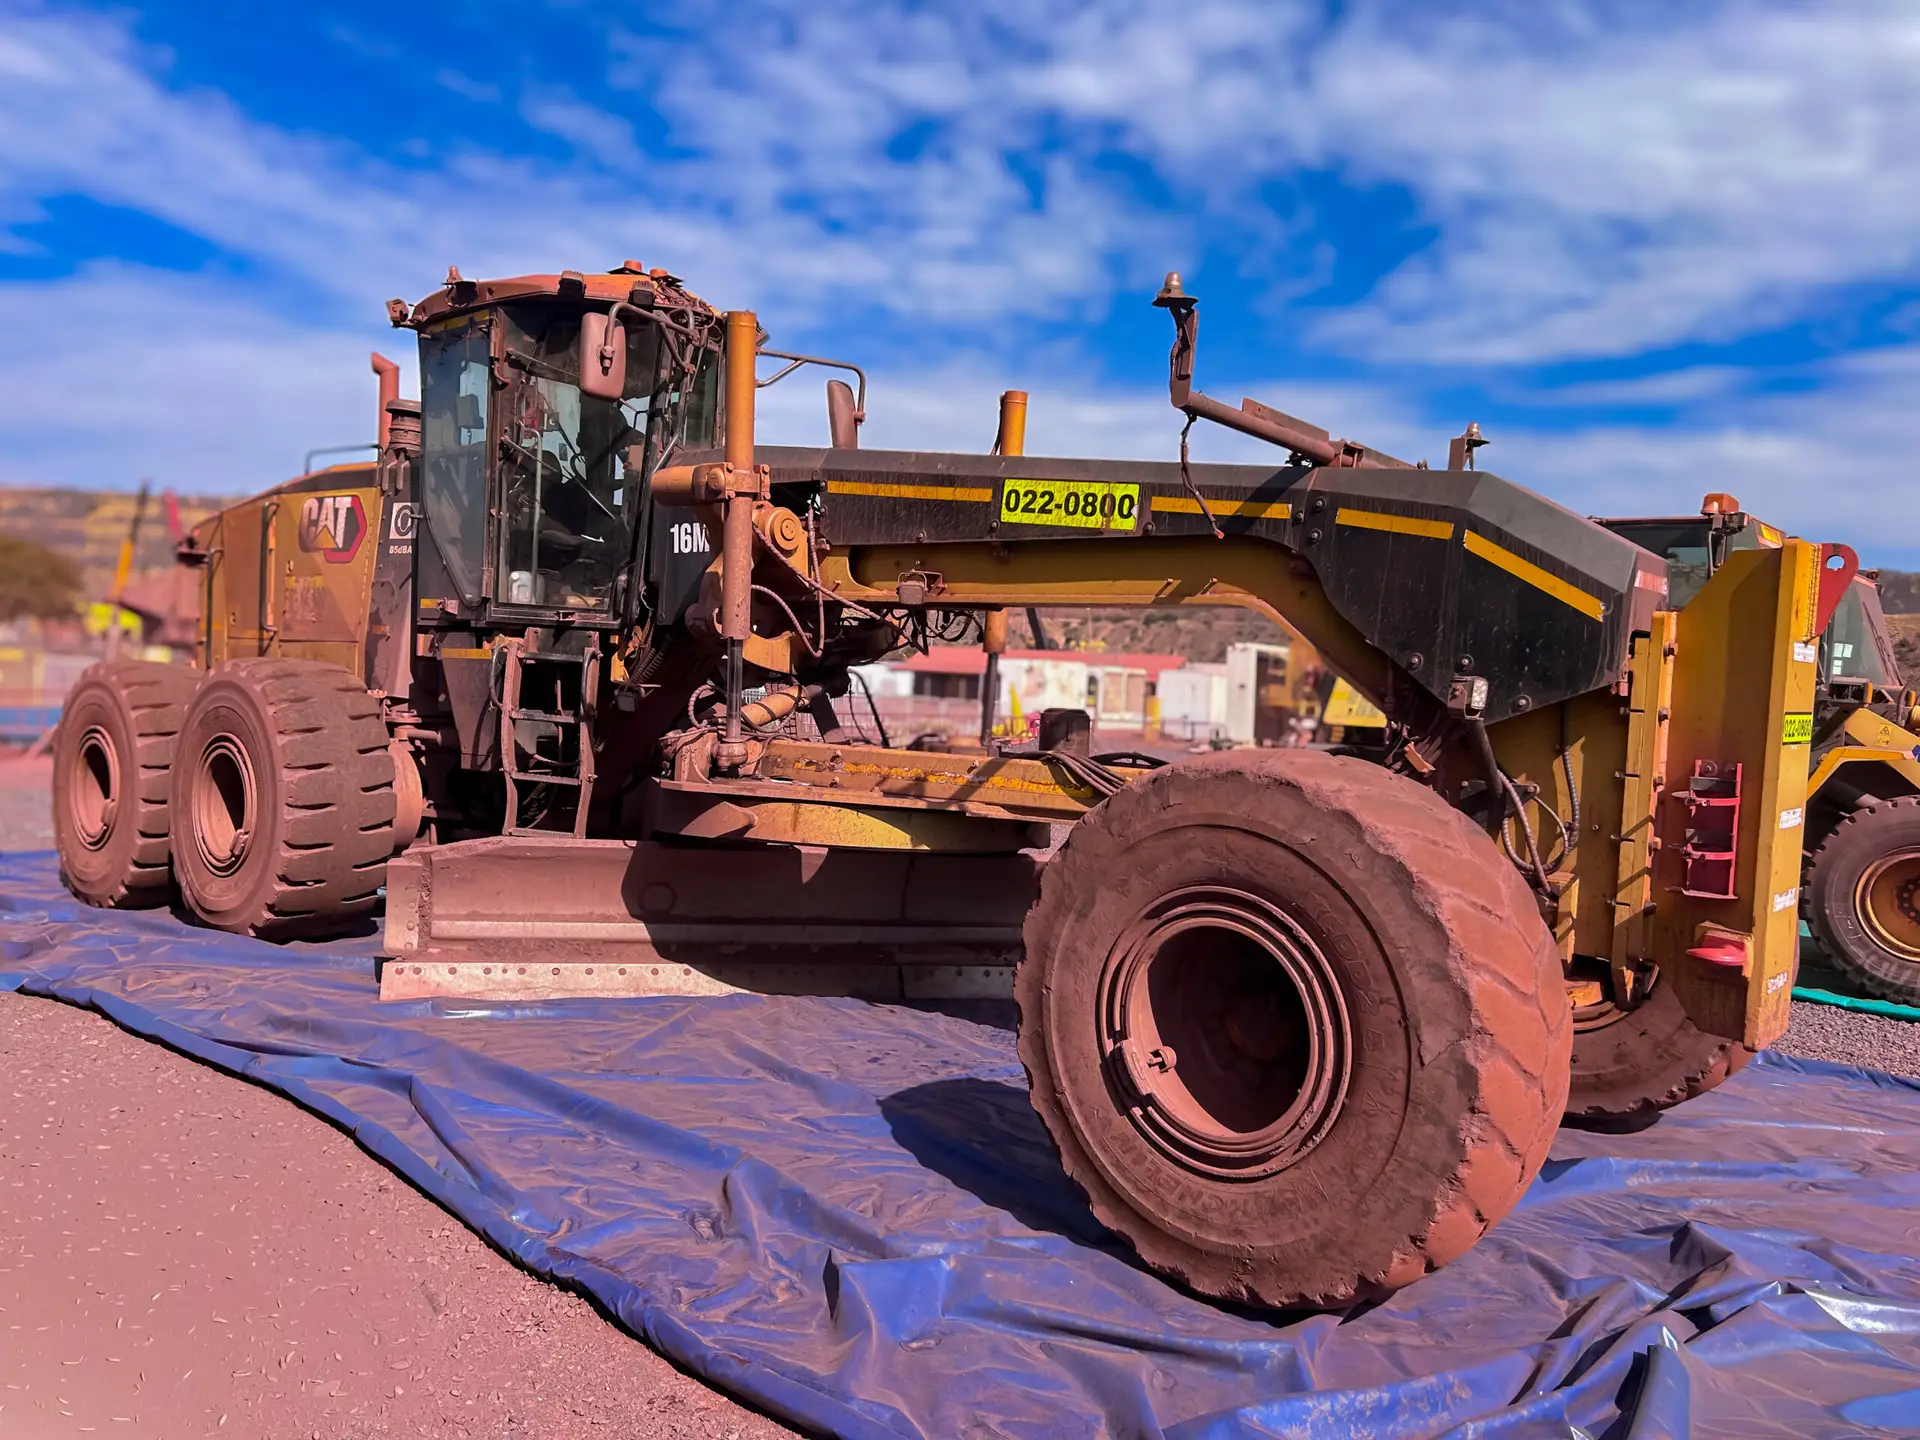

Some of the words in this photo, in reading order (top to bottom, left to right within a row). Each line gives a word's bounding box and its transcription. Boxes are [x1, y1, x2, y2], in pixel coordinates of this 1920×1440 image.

[1004, 488, 1136, 519] 022-0800
[301, 496, 352, 549] CAT
[670, 522, 710, 553] 16M
